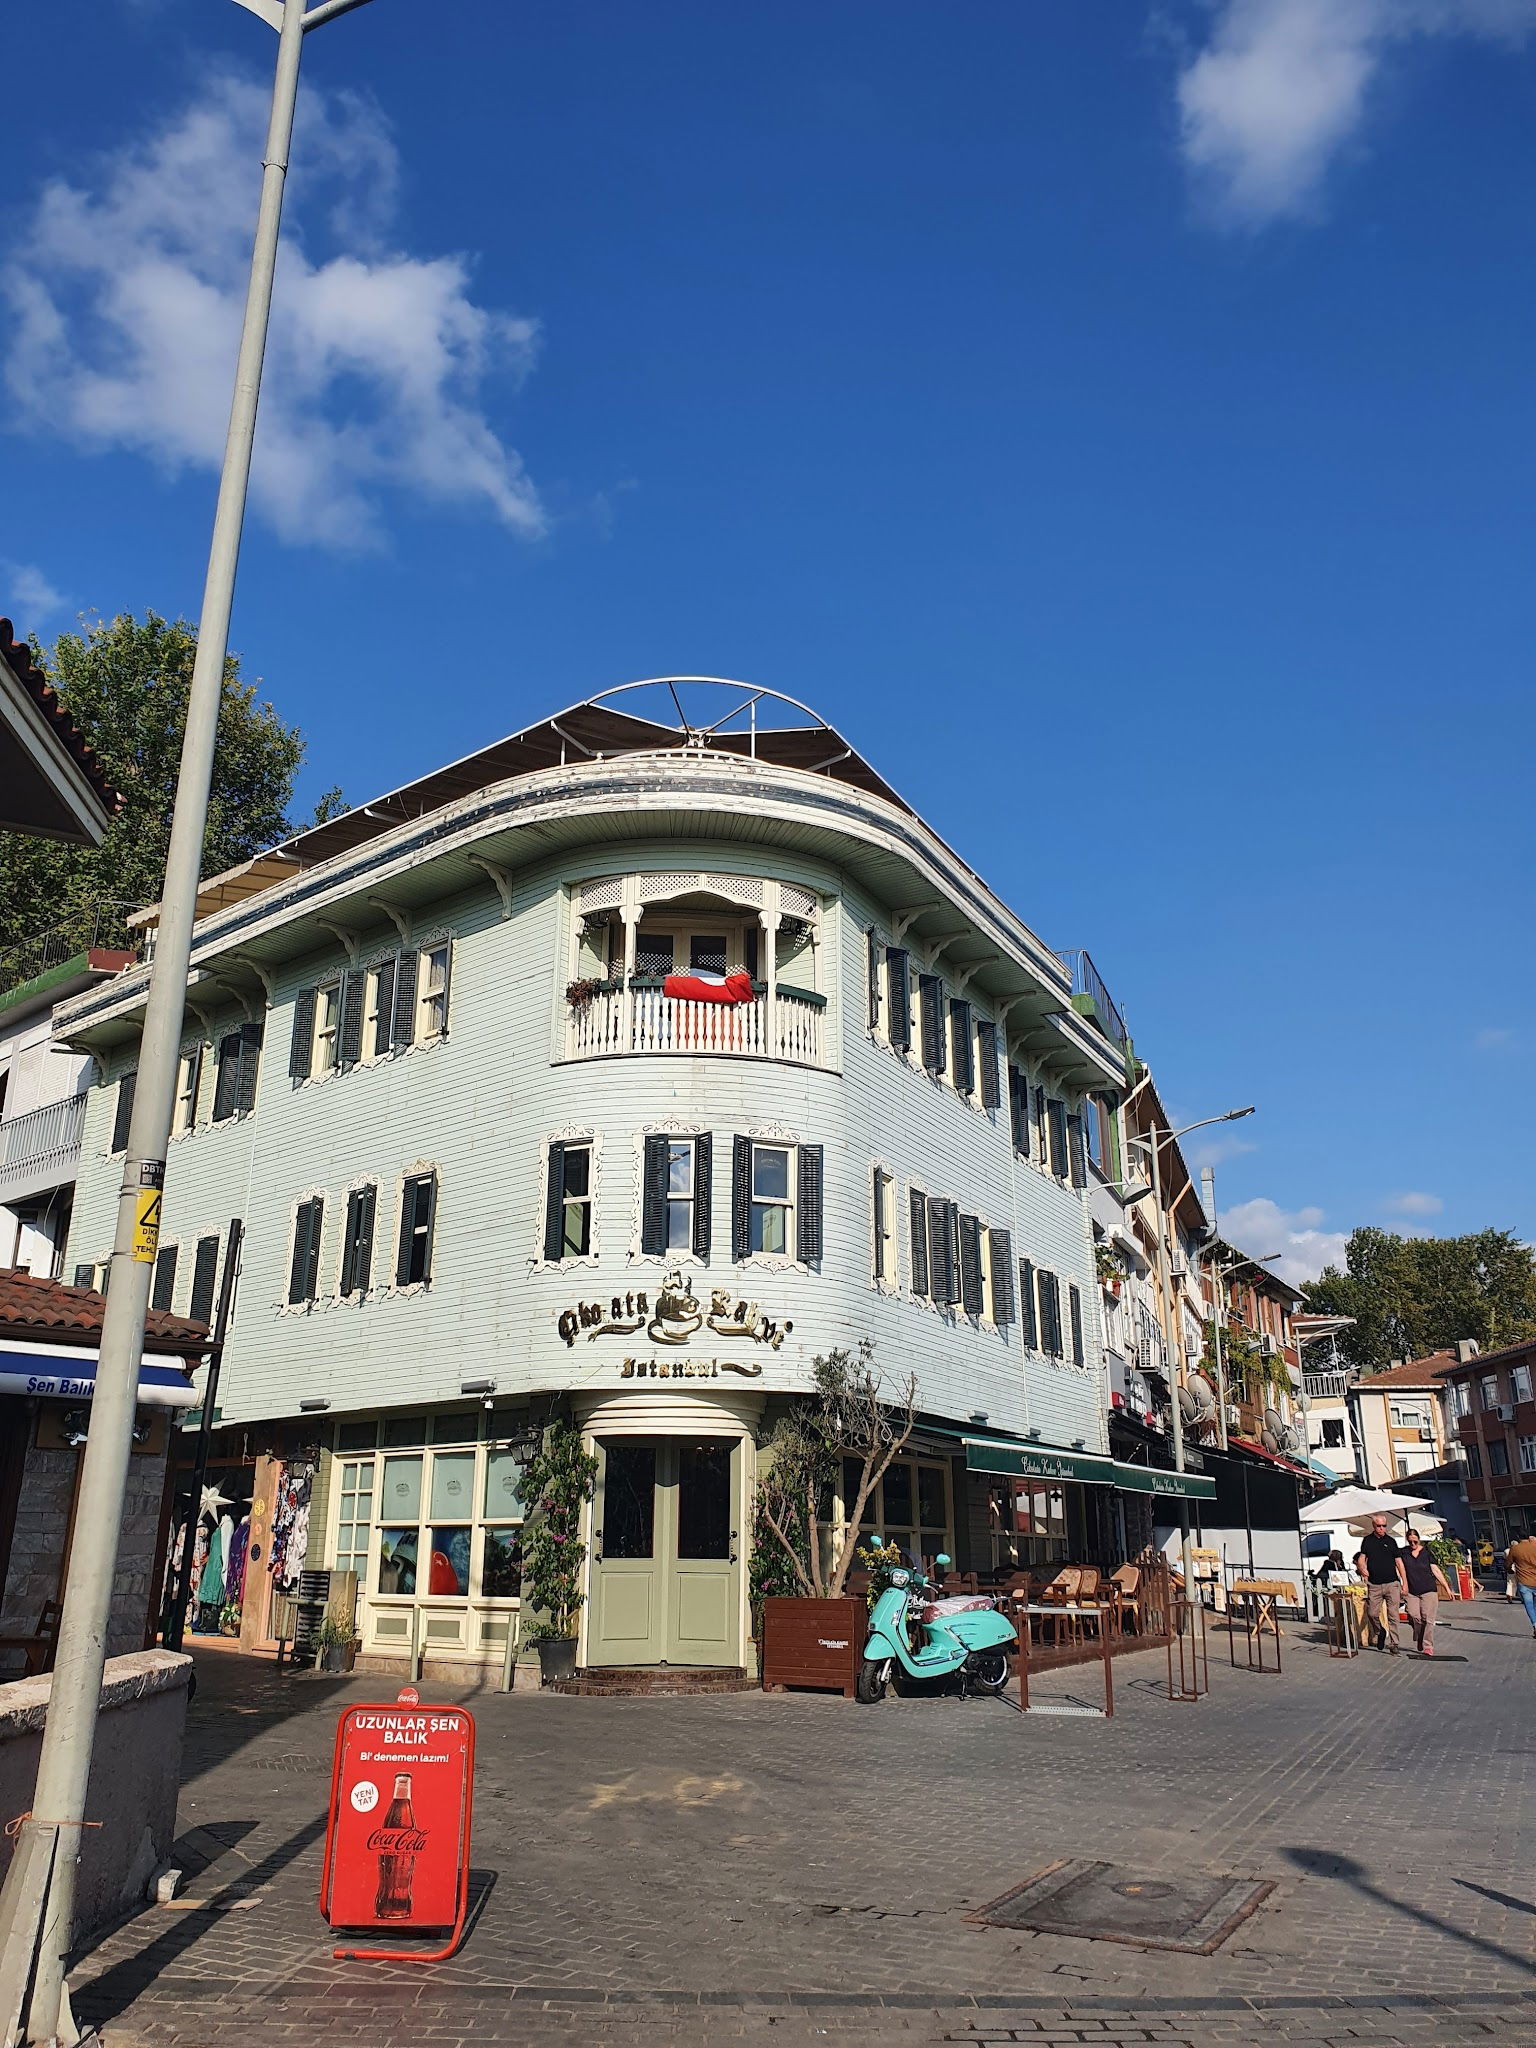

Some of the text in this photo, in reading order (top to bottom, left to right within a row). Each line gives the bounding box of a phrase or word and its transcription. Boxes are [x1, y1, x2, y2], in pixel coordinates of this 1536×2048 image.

[27, 1377, 55, 1394] Şen
[355, 1717, 459, 1732] UZUNLAR ŞEN
[384, 1732, 428, 1744] BALIK
[374, 1752, 418, 1762] denemen
[420, 1753, 449, 1763] lazım!
[354, 1786, 374, 1799] YENİ
[358, 1796, 373, 1806] TAT
[367, 1829, 430, 1851] Coca-Cola
